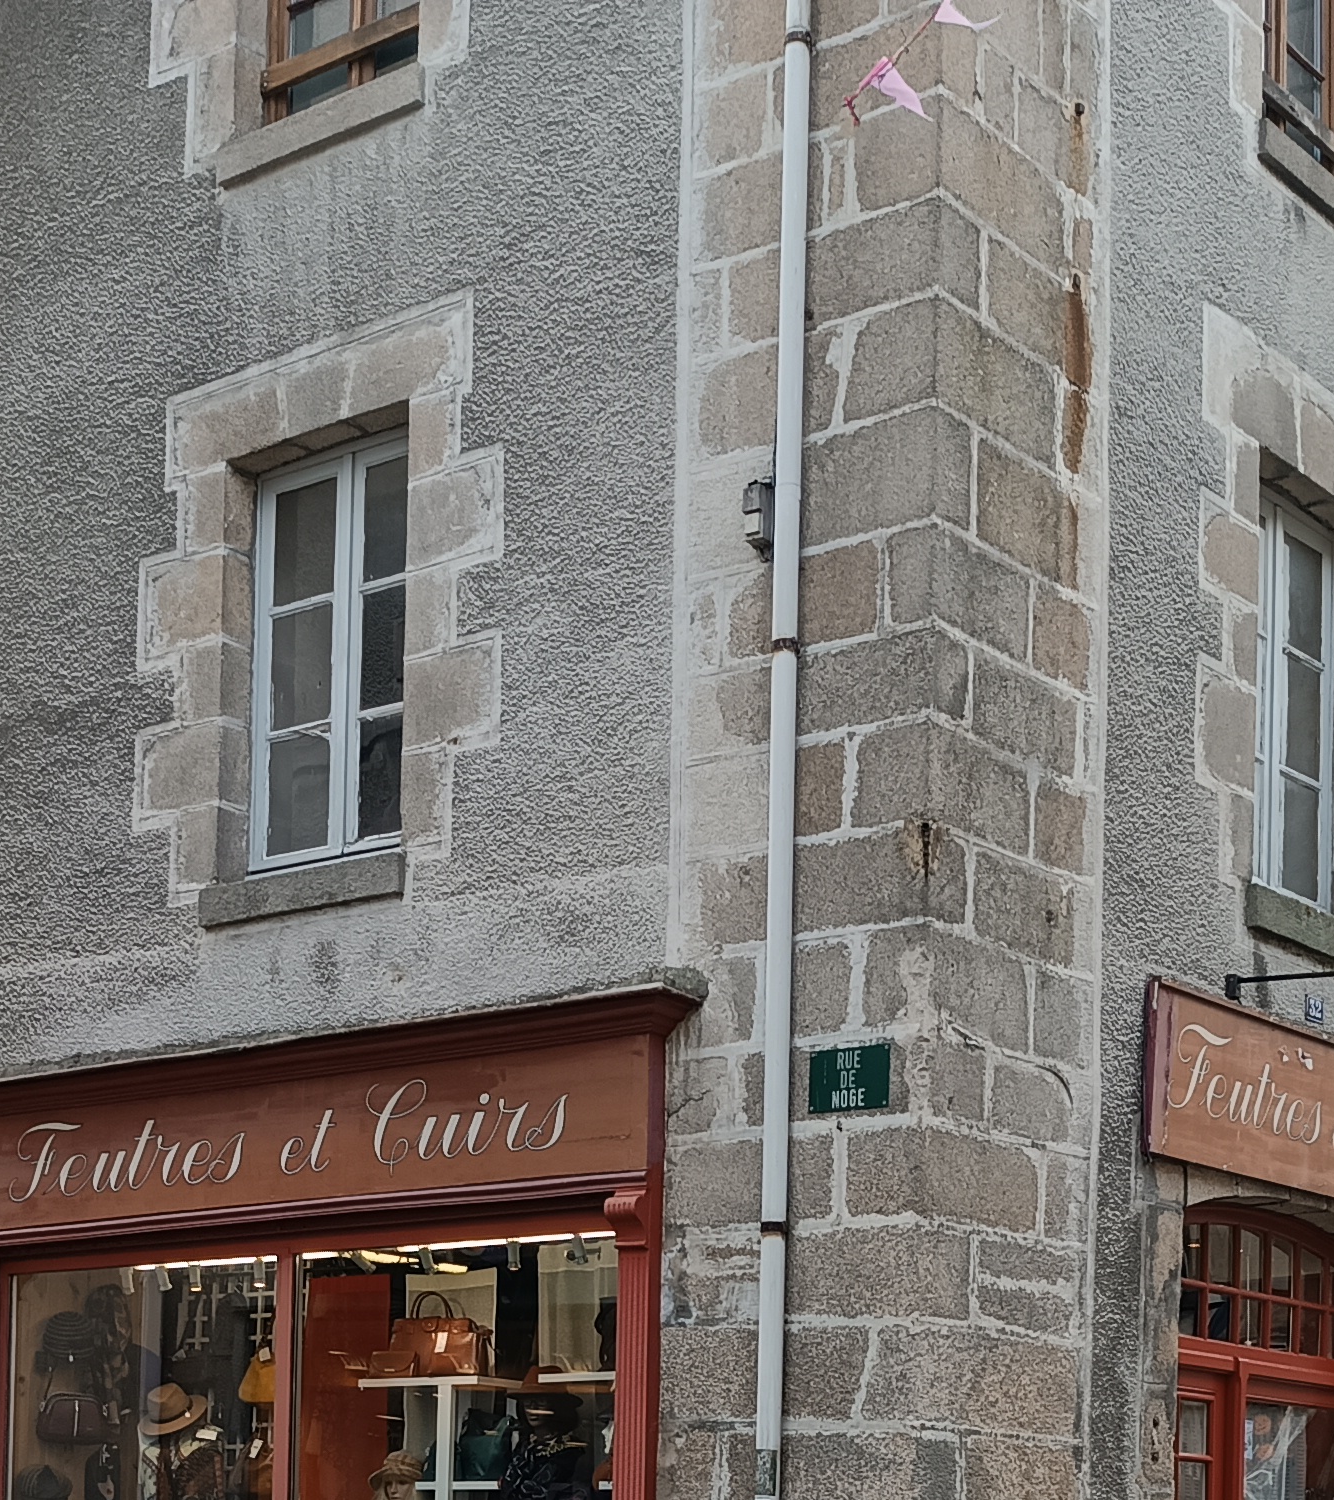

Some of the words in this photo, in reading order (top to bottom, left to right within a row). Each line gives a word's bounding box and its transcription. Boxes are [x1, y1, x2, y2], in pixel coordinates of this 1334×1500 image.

[1309, 998, 1322, 1018] 32
[837, 1050, 861, 1069] RUE
[840, 1070, 856, 1088] DE
[1167, 1024, 1323, 1144] Feutres
[832, 1088, 865, 1108] NOGE
[8, 1119, 245, 1203] Feutres
[280, 1109, 336, 1175] et
[366, 1078, 570, 1176] Cuirs
